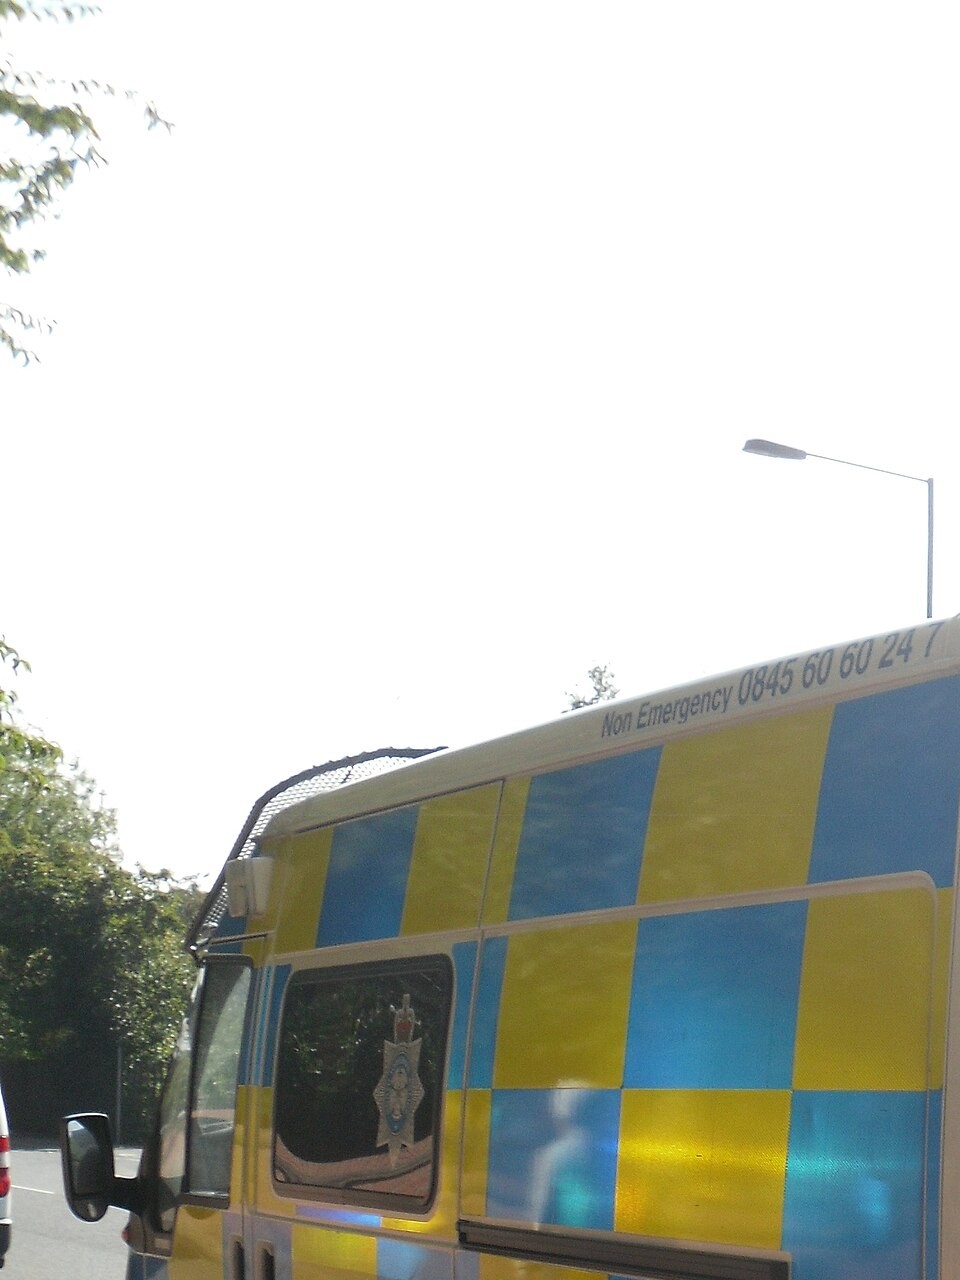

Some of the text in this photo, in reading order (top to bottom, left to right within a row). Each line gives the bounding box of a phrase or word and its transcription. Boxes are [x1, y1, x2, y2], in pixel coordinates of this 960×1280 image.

[601, 709, 632, 738] Non
[636, 684, 733, 729] Emergency
[738, 658, 796, 705] 0845
[801, 650, 834, 689] 60
[839, 639, 873, 679] 60
